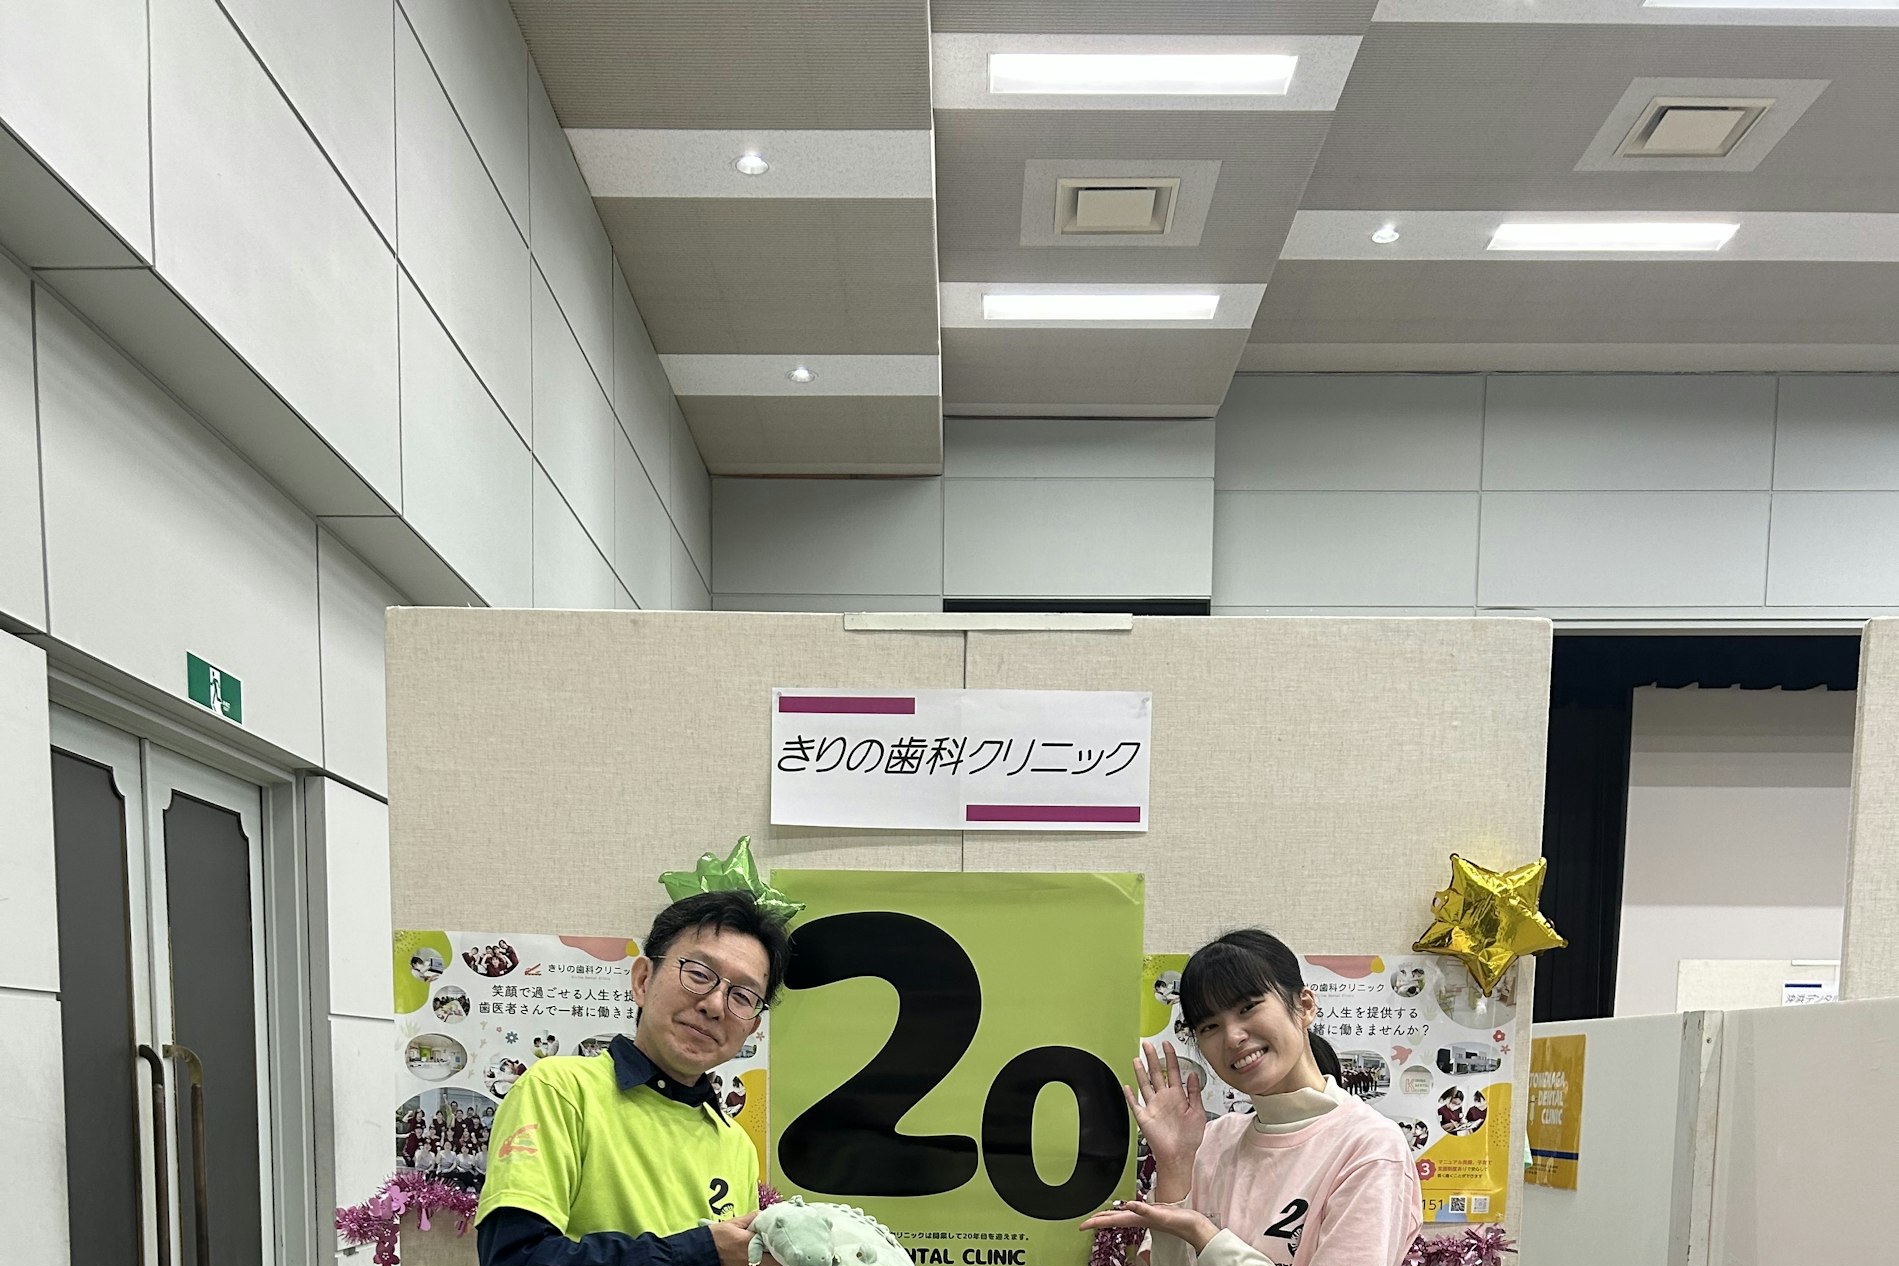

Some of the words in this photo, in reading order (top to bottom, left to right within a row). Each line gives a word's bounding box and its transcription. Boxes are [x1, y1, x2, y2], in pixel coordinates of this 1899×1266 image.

[778, 735, 1141, 776] きりの歯科クリニック
[548, 963, 632, 976] きりの歯科クリニッ
[492, 984, 635, 1002] 笑顔で過ごせる人生を提
[479, 1002, 637, 1020] 歯医者さんで一緒に働きま
[1309, 1023, 1431, 1037] 緒に働きませんか？
[777, 911, 1131, 1221] 20
[1420, 1162, 1431, 1176] 3
[962, 1248, 1026, 1266] CLINIC
